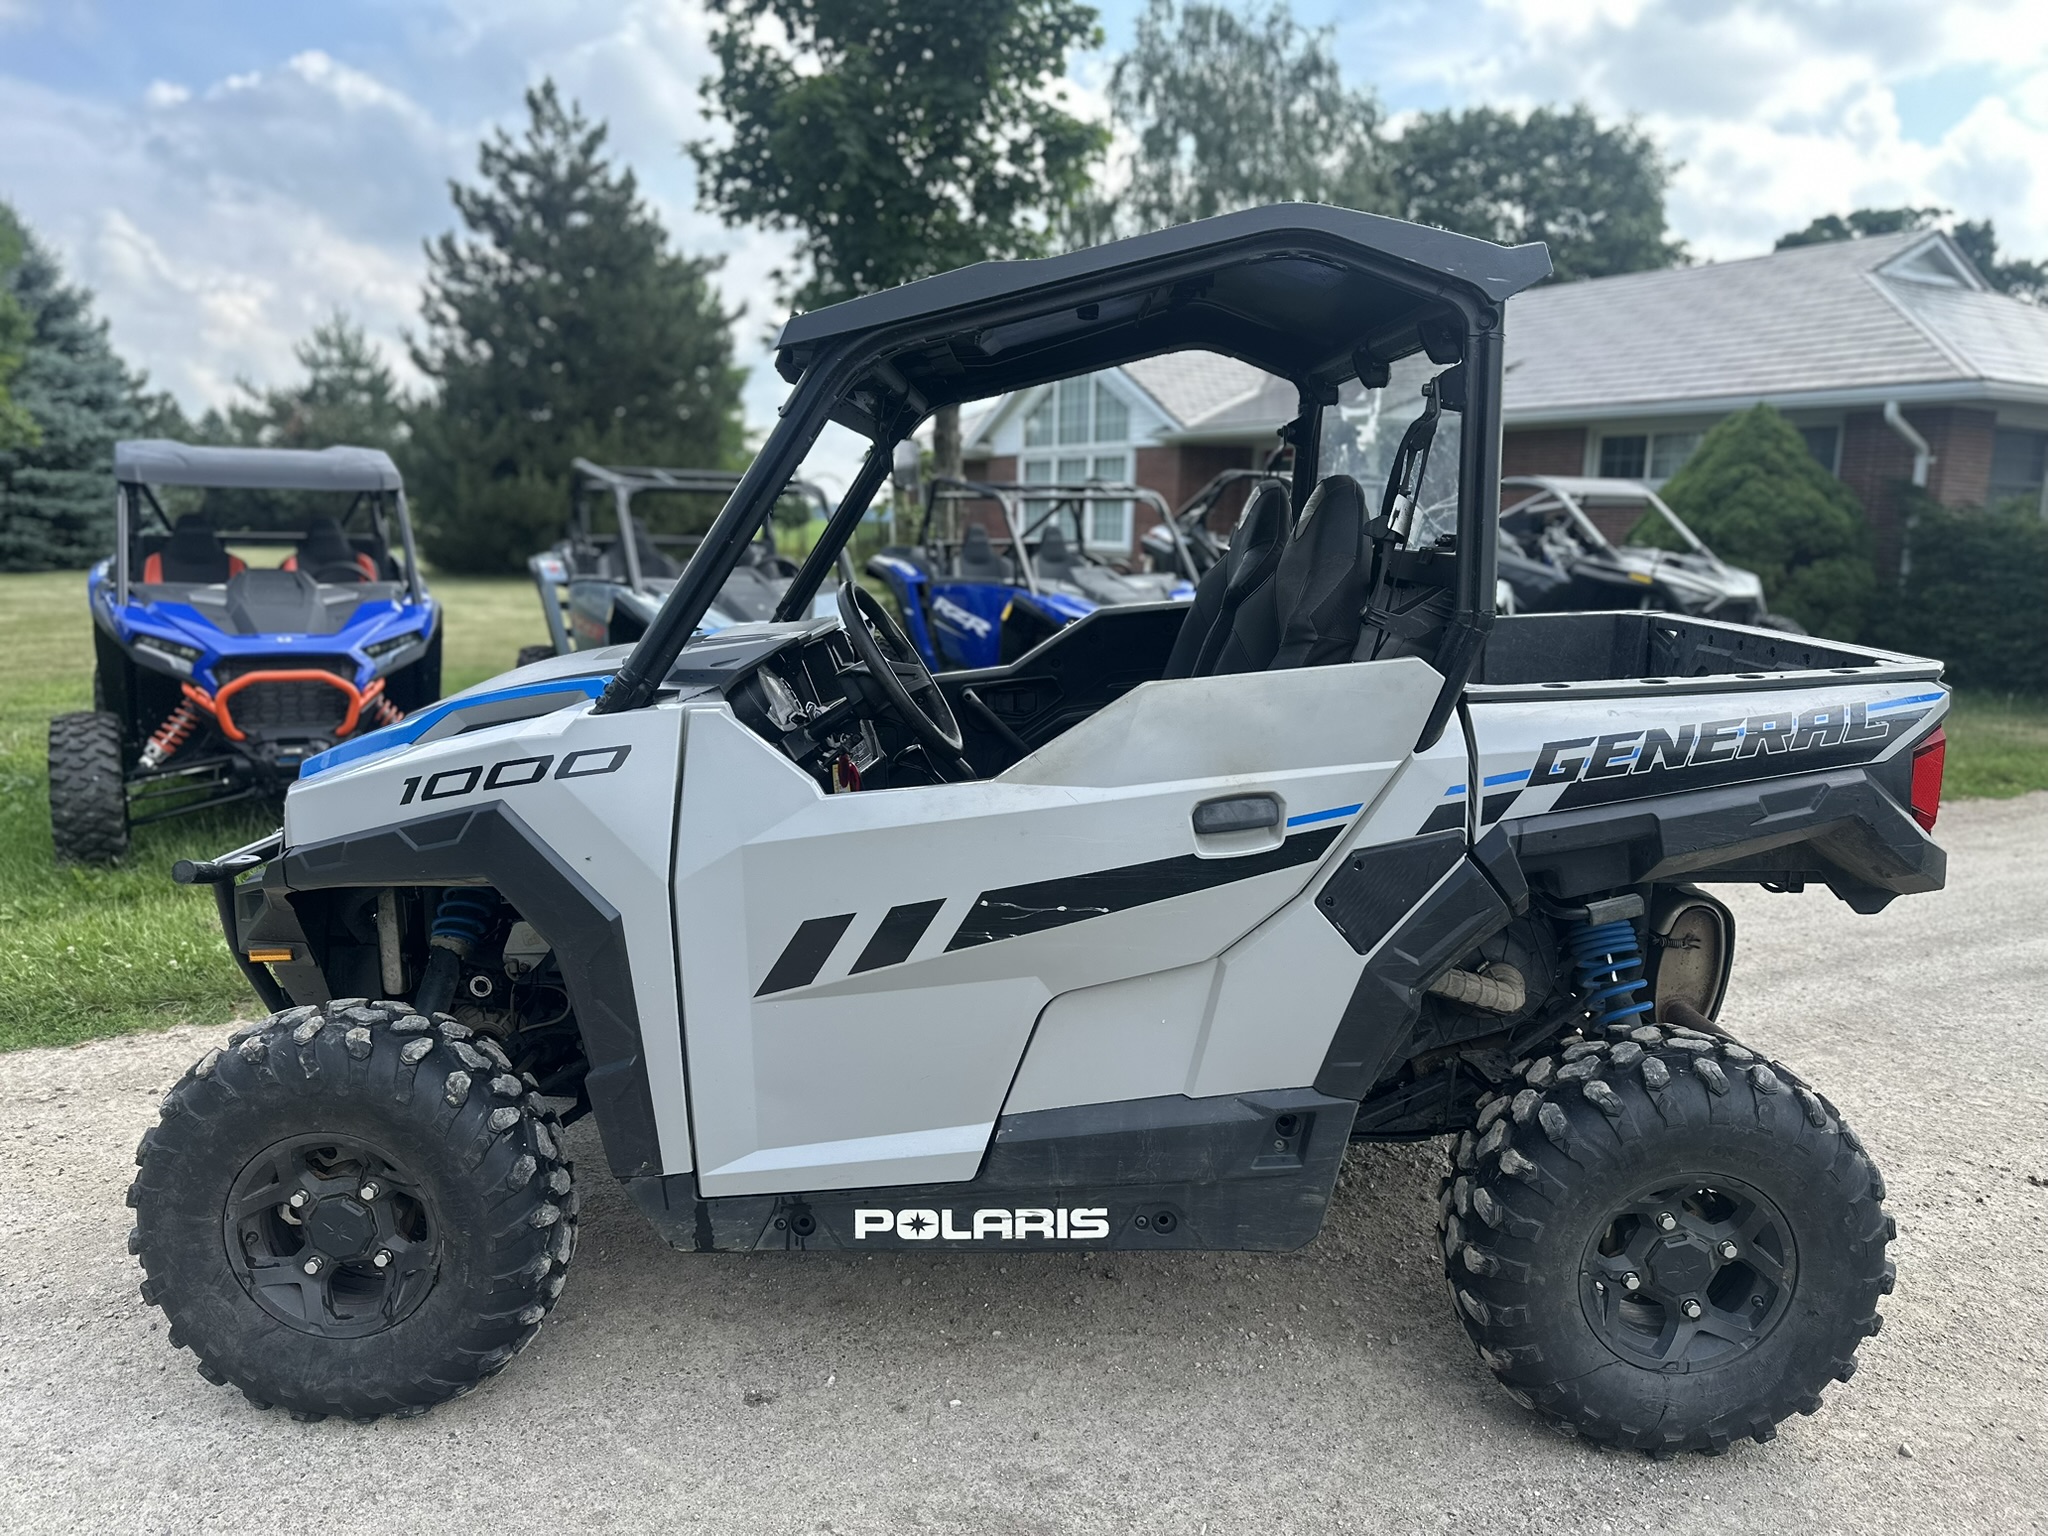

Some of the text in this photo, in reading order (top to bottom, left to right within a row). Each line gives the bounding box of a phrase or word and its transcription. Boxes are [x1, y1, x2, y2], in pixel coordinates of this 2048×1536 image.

[932, 596, 992, 638] RZR
[1526, 702, 1889, 787] GENERAL
[400, 745, 632, 805] 1000
[854, 1208, 1110, 1240] POLARIS
